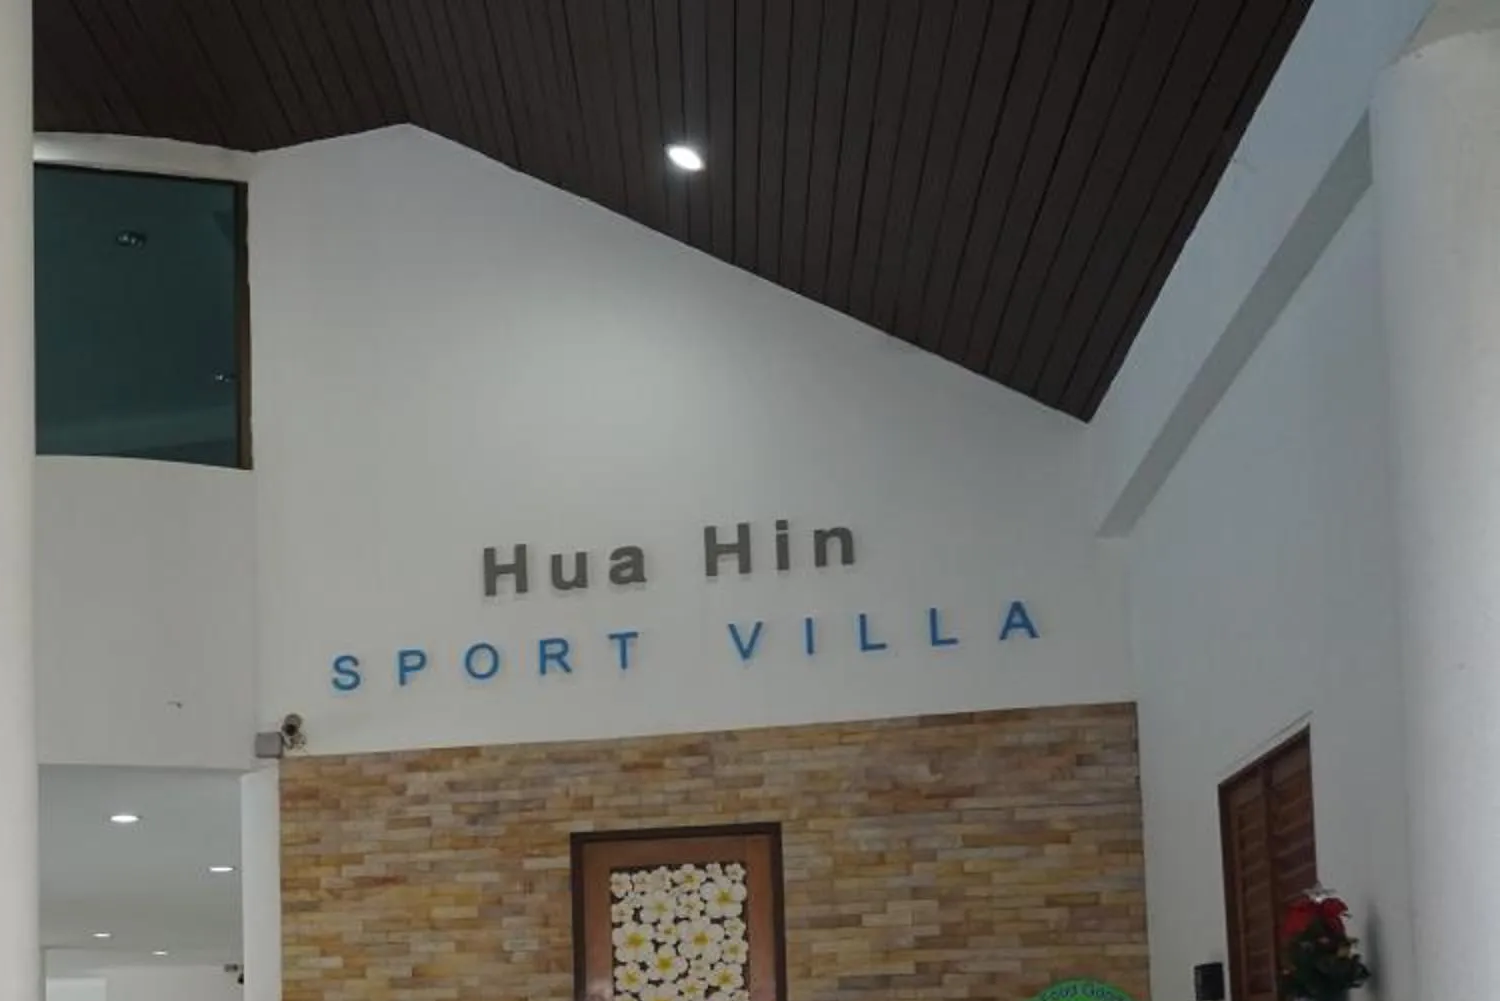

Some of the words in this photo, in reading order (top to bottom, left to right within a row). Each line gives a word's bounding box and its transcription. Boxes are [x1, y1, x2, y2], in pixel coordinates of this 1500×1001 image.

[482, 543, 648, 597] Hua
[703, 519, 857, 577] Hin
[331, 631, 641, 692] SPORT
[728, 600, 1041, 662] VILLA
